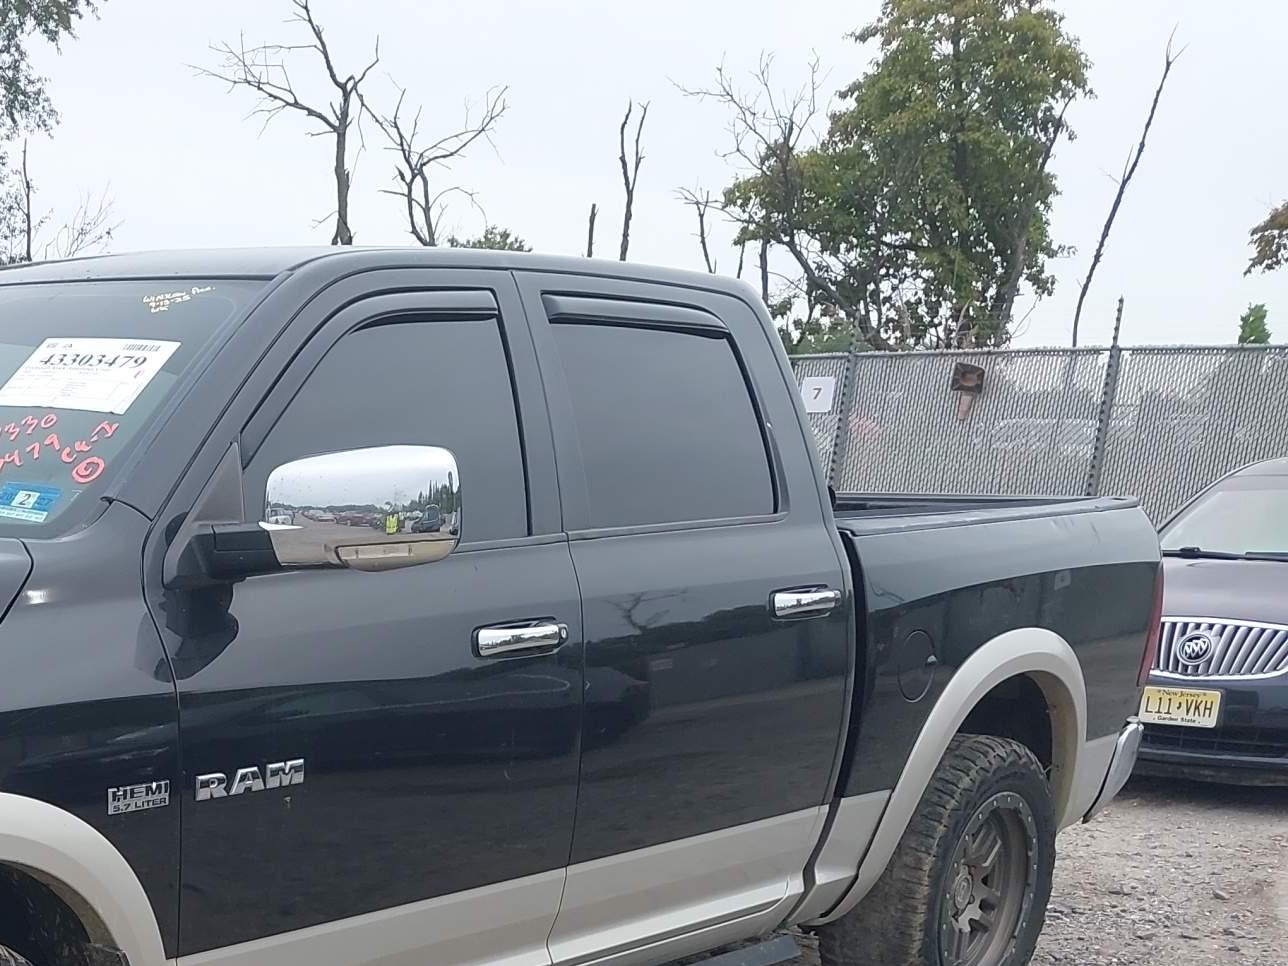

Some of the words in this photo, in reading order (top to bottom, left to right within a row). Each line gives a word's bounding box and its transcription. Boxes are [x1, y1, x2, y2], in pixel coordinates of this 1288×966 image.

[40, 353, 147, 368] 43303479
[812, 387, 822, 400] 7
[18, 493, 31, 505] 2
[1178, 690, 1200, 698] Jersey
[195, 758, 304, 801] RAM
[111, 781, 169, 803] HEMI
[112, 801, 131, 813] 5.7
[133, 796, 167, 810] LITER
